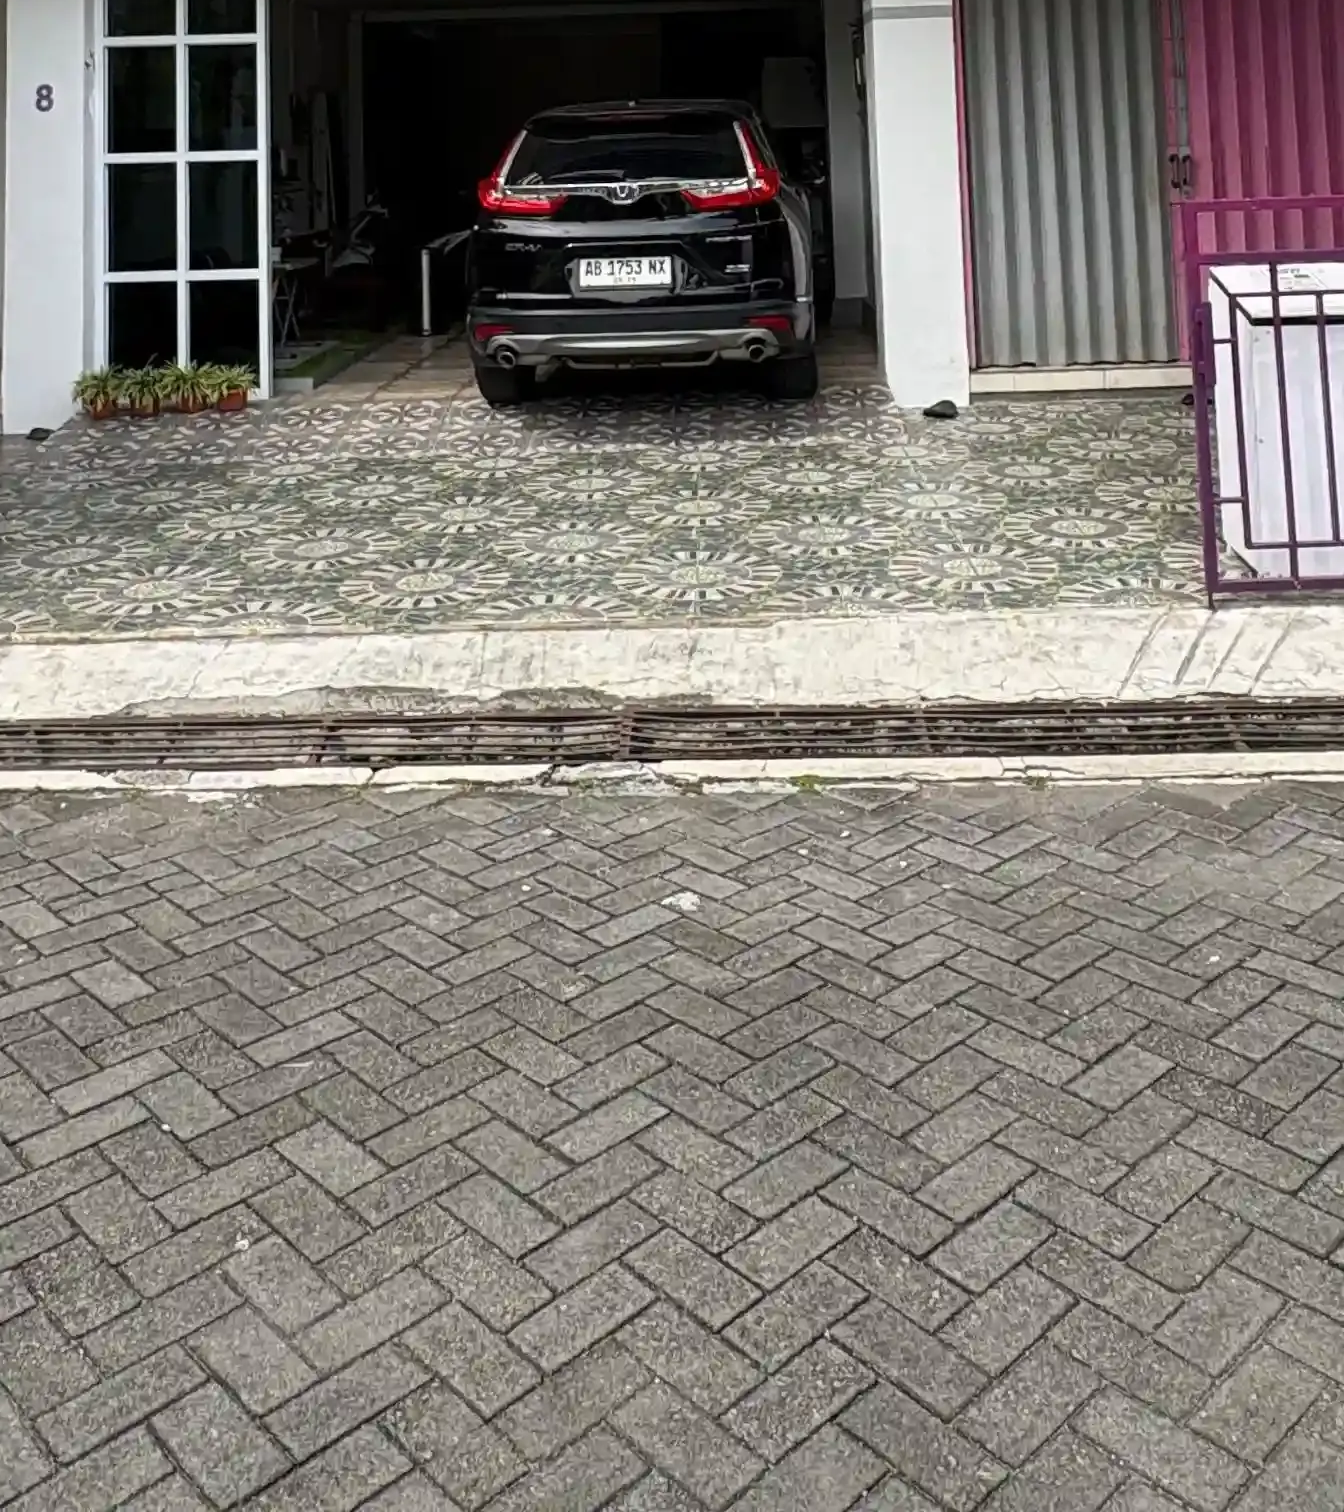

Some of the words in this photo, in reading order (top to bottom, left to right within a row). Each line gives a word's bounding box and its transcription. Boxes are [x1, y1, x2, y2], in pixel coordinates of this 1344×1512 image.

[36, 84, 54, 112] 8
[585, 260, 602, 276] AB
[607, 259, 642, 275] 1753
[648, 259, 666, 274] NX
